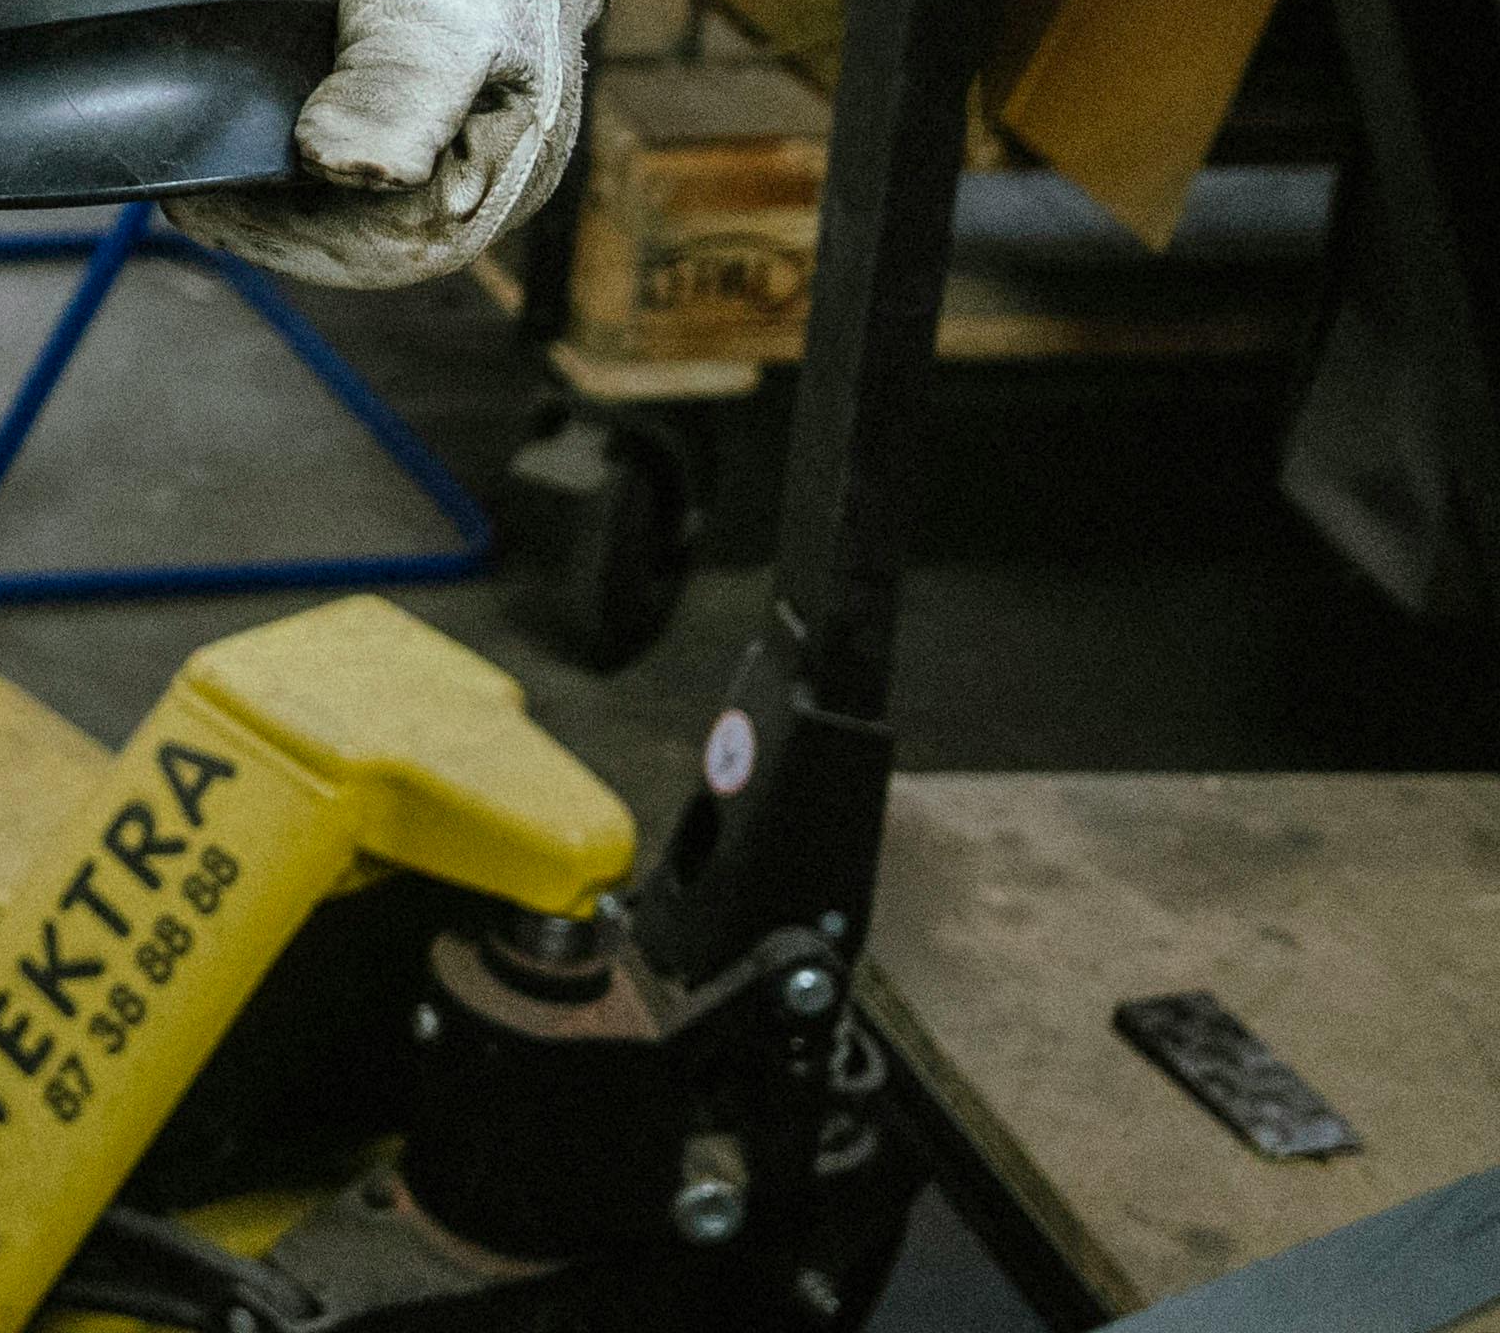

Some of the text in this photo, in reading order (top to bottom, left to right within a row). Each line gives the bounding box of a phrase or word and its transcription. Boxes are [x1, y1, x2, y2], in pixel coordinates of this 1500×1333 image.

[43, 844, 241, 1125] 87 38 88 88
